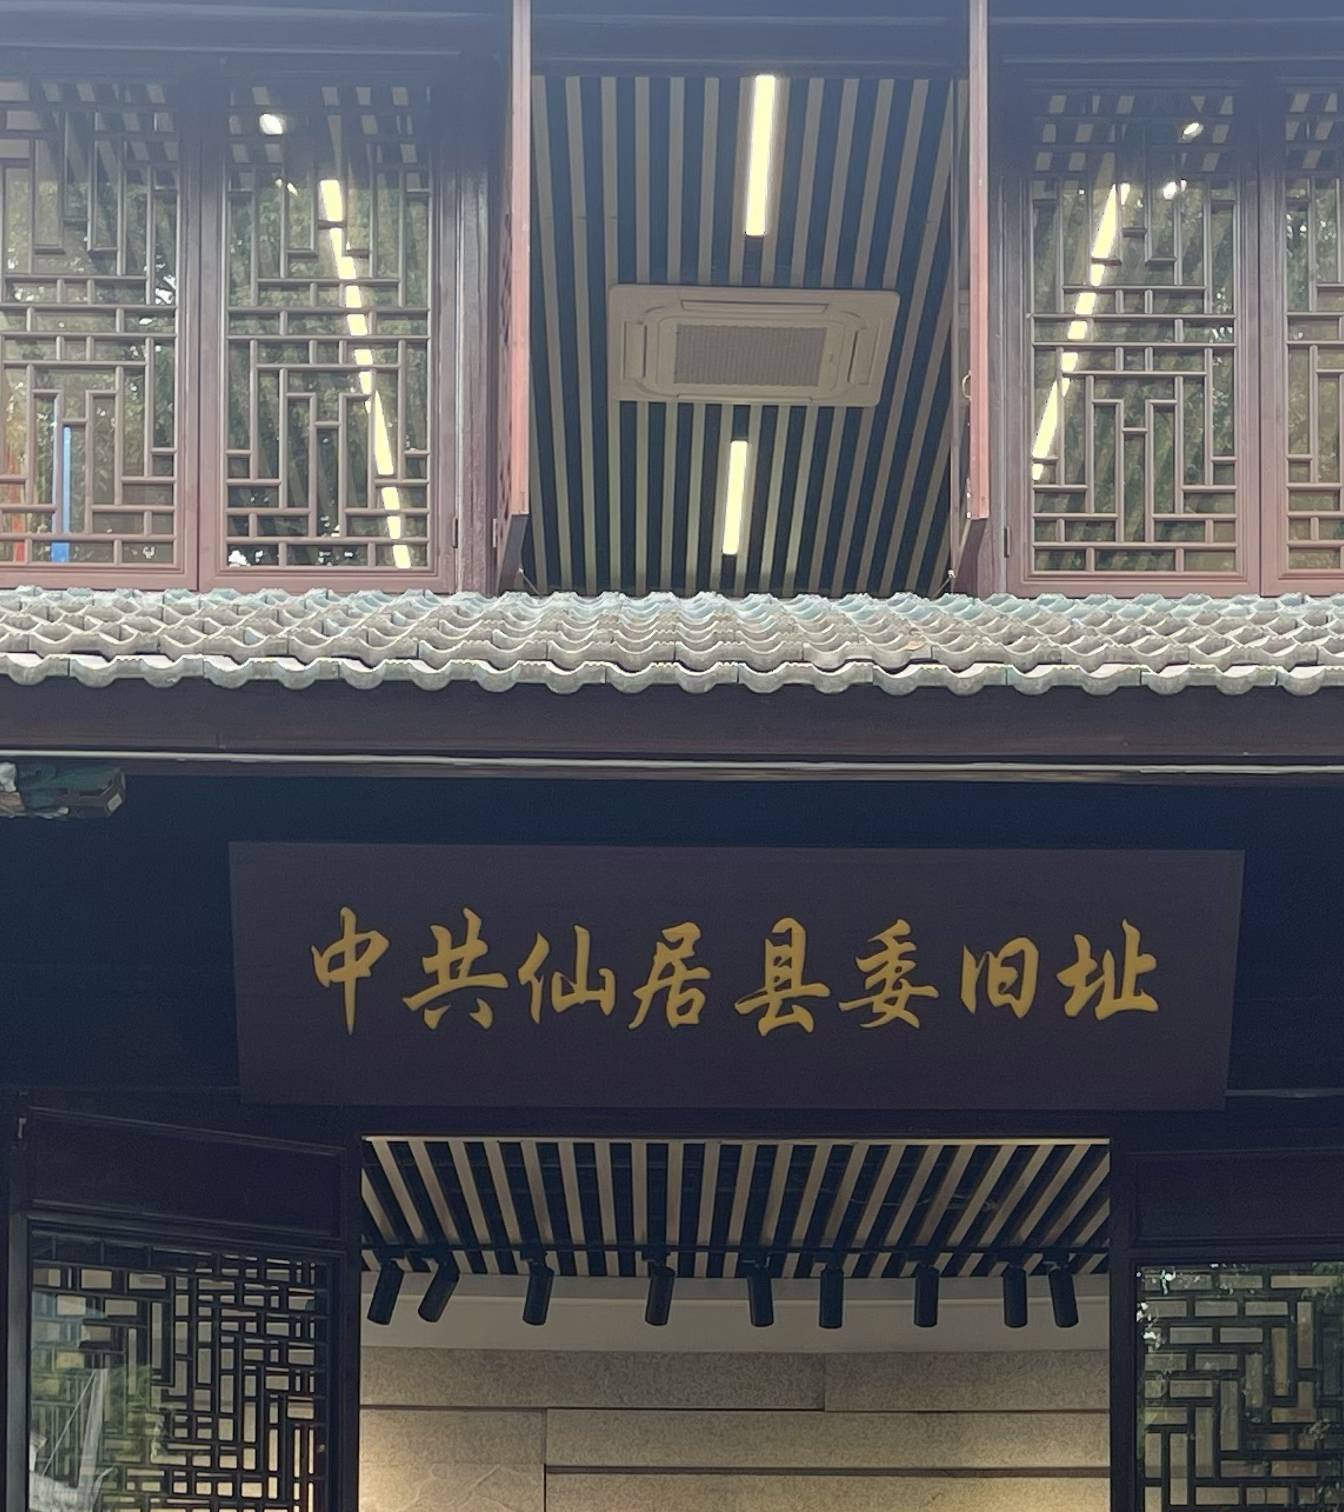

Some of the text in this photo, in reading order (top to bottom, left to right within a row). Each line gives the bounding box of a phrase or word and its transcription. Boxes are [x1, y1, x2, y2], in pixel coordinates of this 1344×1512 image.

[311, 907, 1159, 1036] 中共仙居县委旧址
